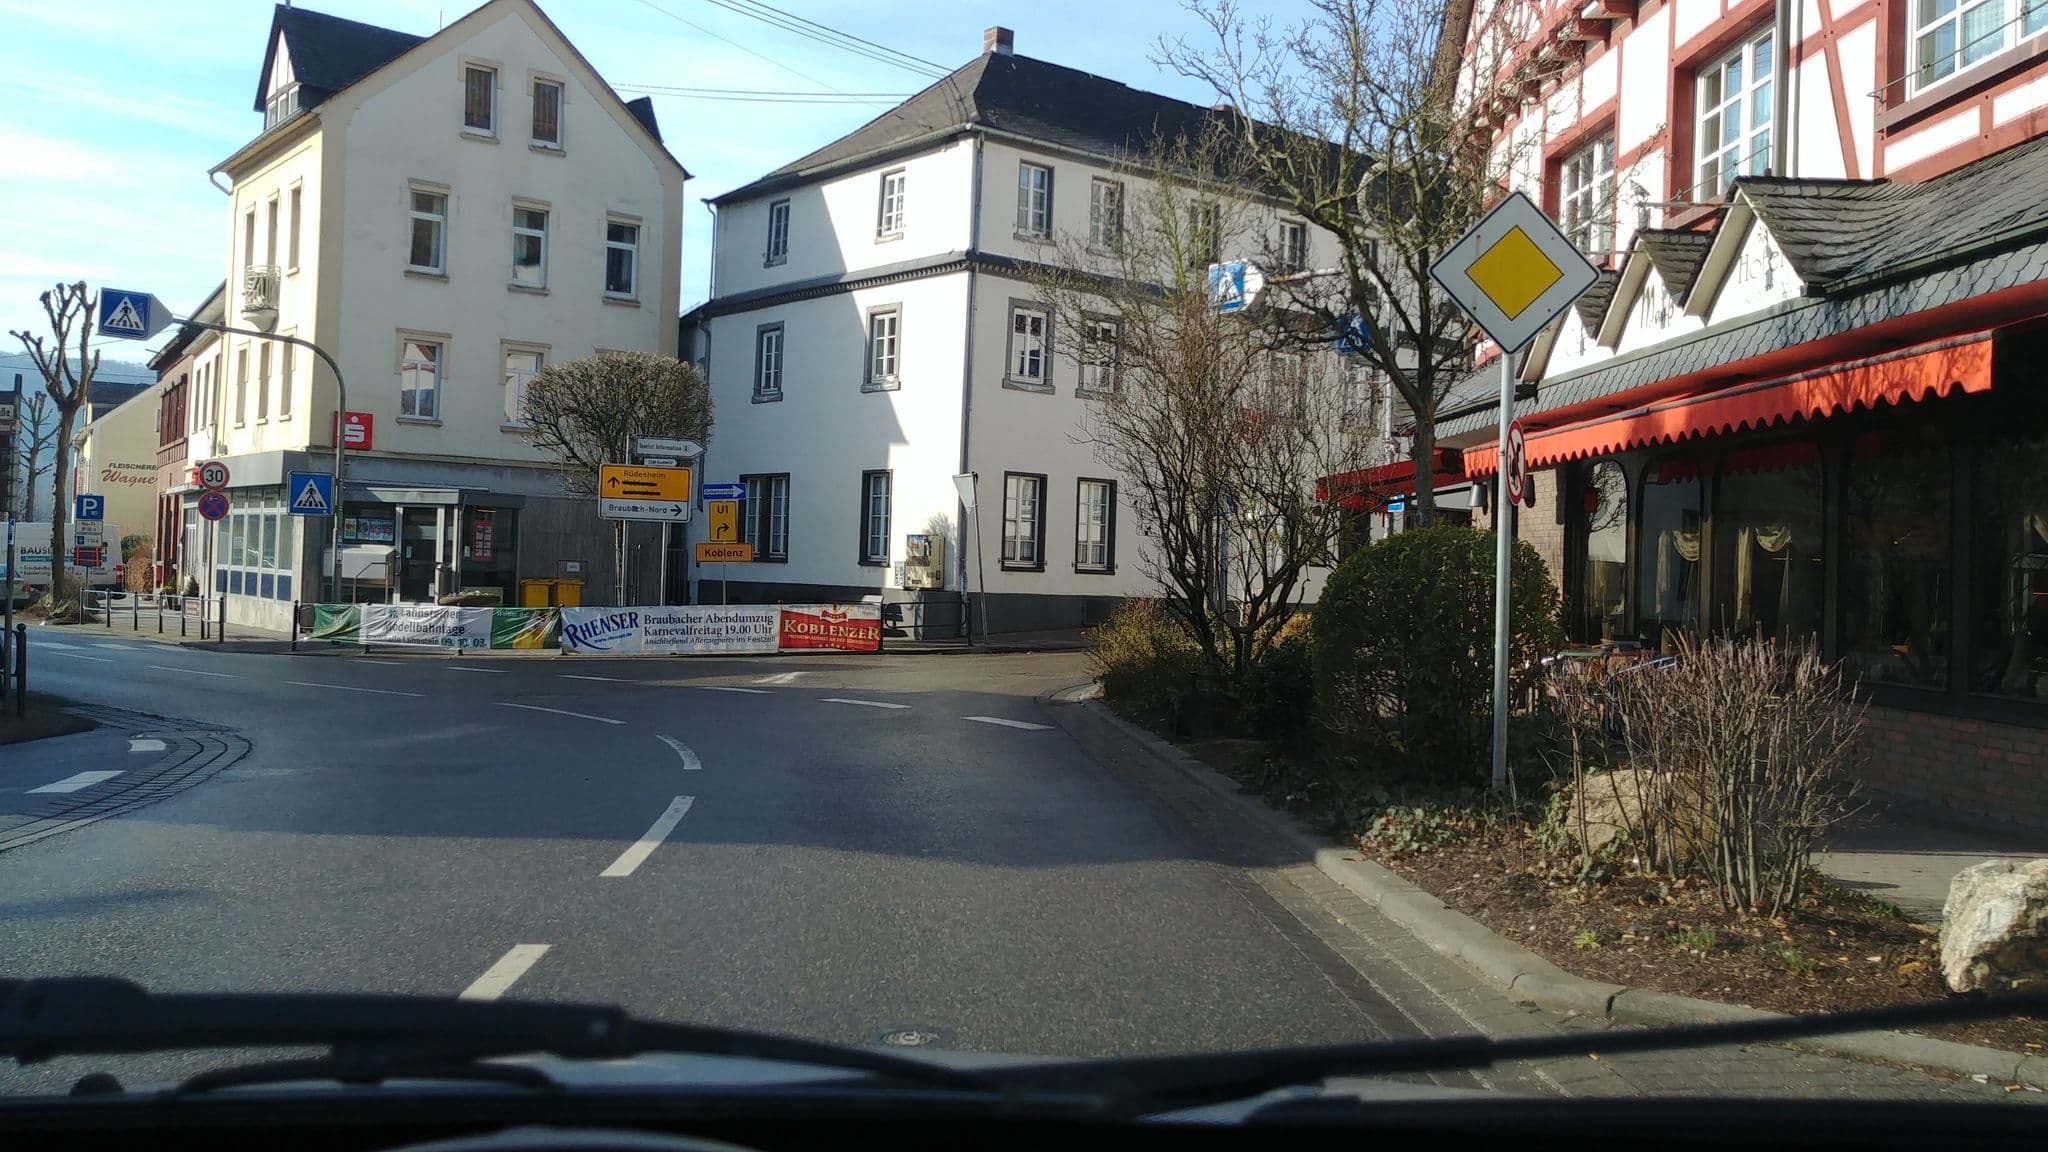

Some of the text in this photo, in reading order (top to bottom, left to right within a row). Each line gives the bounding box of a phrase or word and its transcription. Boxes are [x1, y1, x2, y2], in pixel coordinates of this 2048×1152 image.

[101, 469, 158, 487] Wagne
[206, 469, 223, 483] 30
[623, 470, 666, 479] Rüdesheim
[608, 504, 667, 513] Braubh-Nord
[717, 505, 728, 514] U1
[704, 549, 743, 558] Koblenz
[644, 612, 773, 626] Braubacher Abendumzug
[564, 612, 639, 649] RHENSER
[644, 624, 772, 637] Karnevalfreitag 19.00 Uhr
[783, 619, 880, 641] KOBLENZER
[645, 637, 688, 646] Anschließend
